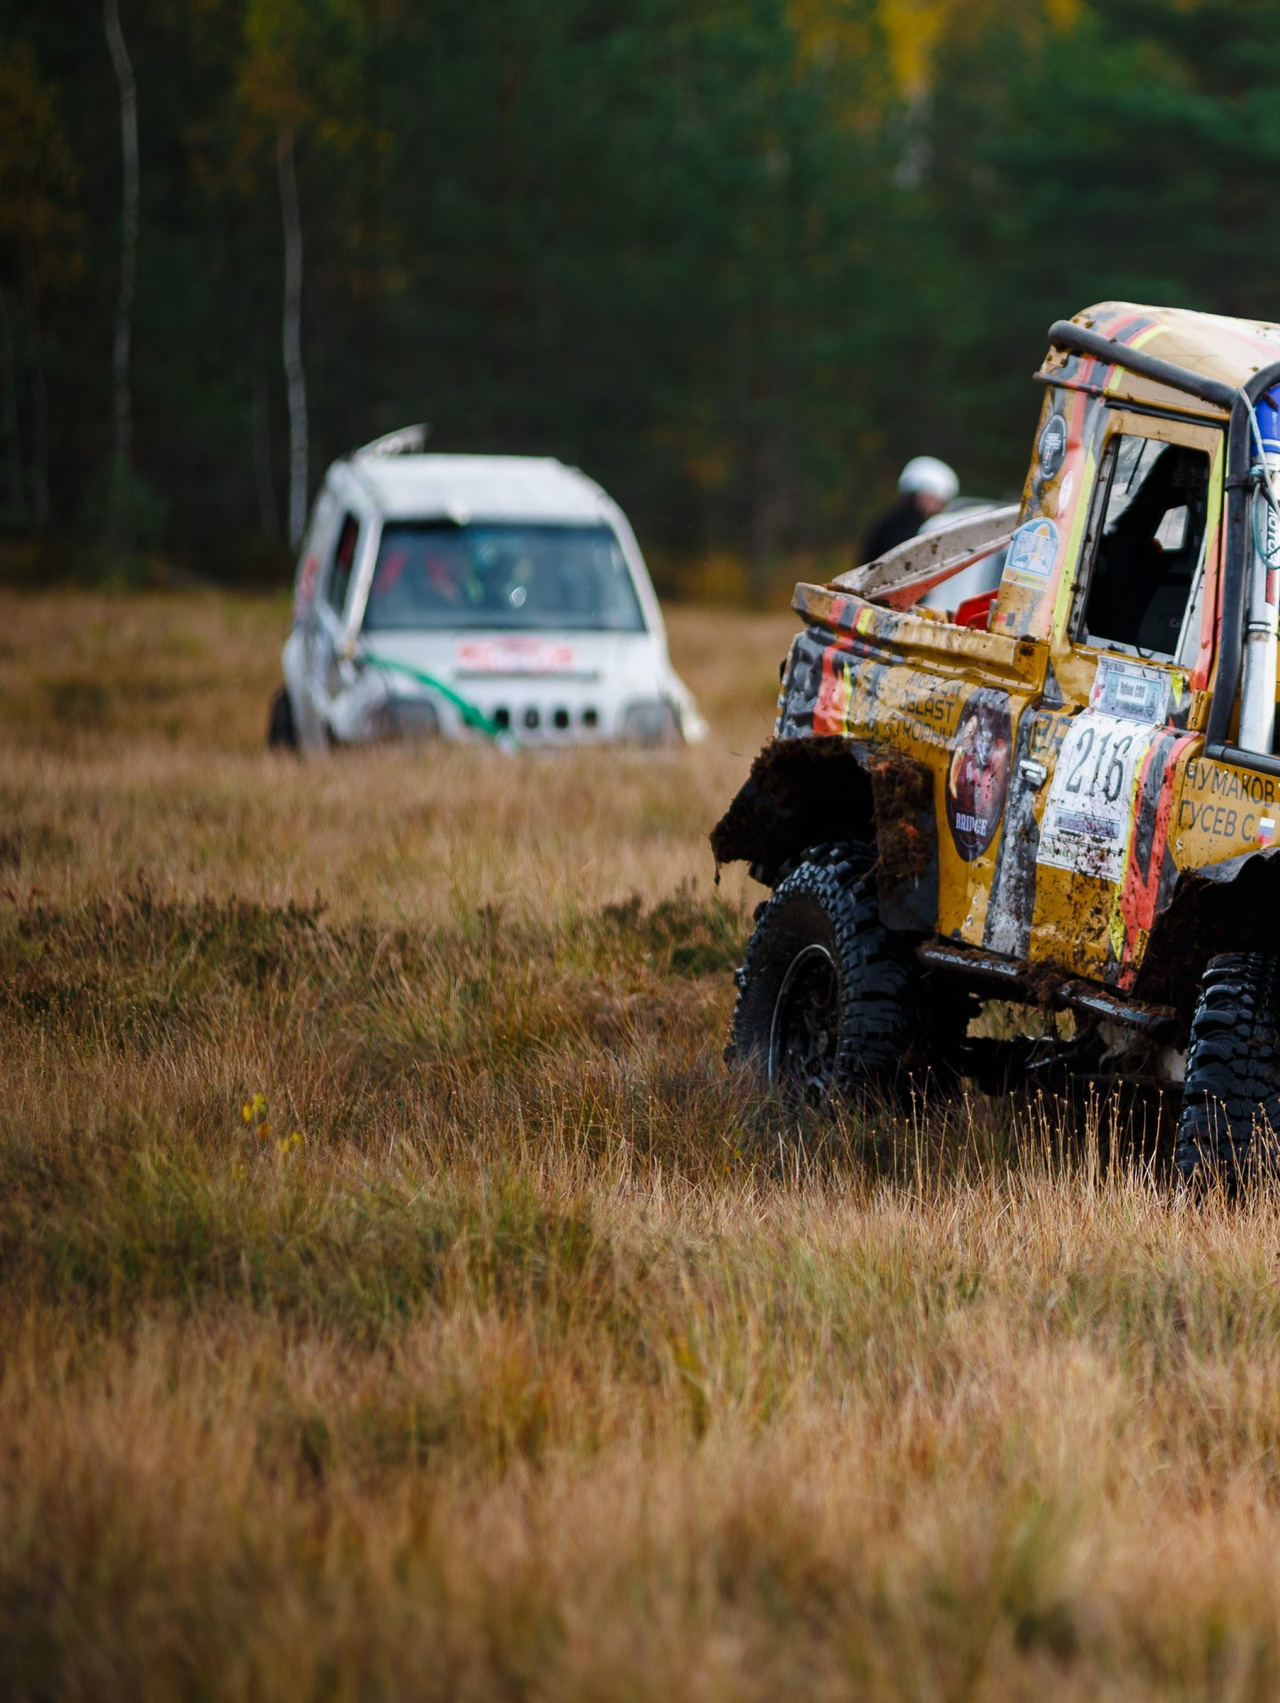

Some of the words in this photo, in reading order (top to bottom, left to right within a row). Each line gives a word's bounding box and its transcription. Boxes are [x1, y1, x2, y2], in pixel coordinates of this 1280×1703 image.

[1065, 727, 1133, 802] 216
[1185, 759, 1275, 808] ЧУМАКОВ
[955, 812, 988, 837] BRIDGE
[1178, 799, 1238, 837] ГУСЕВ
